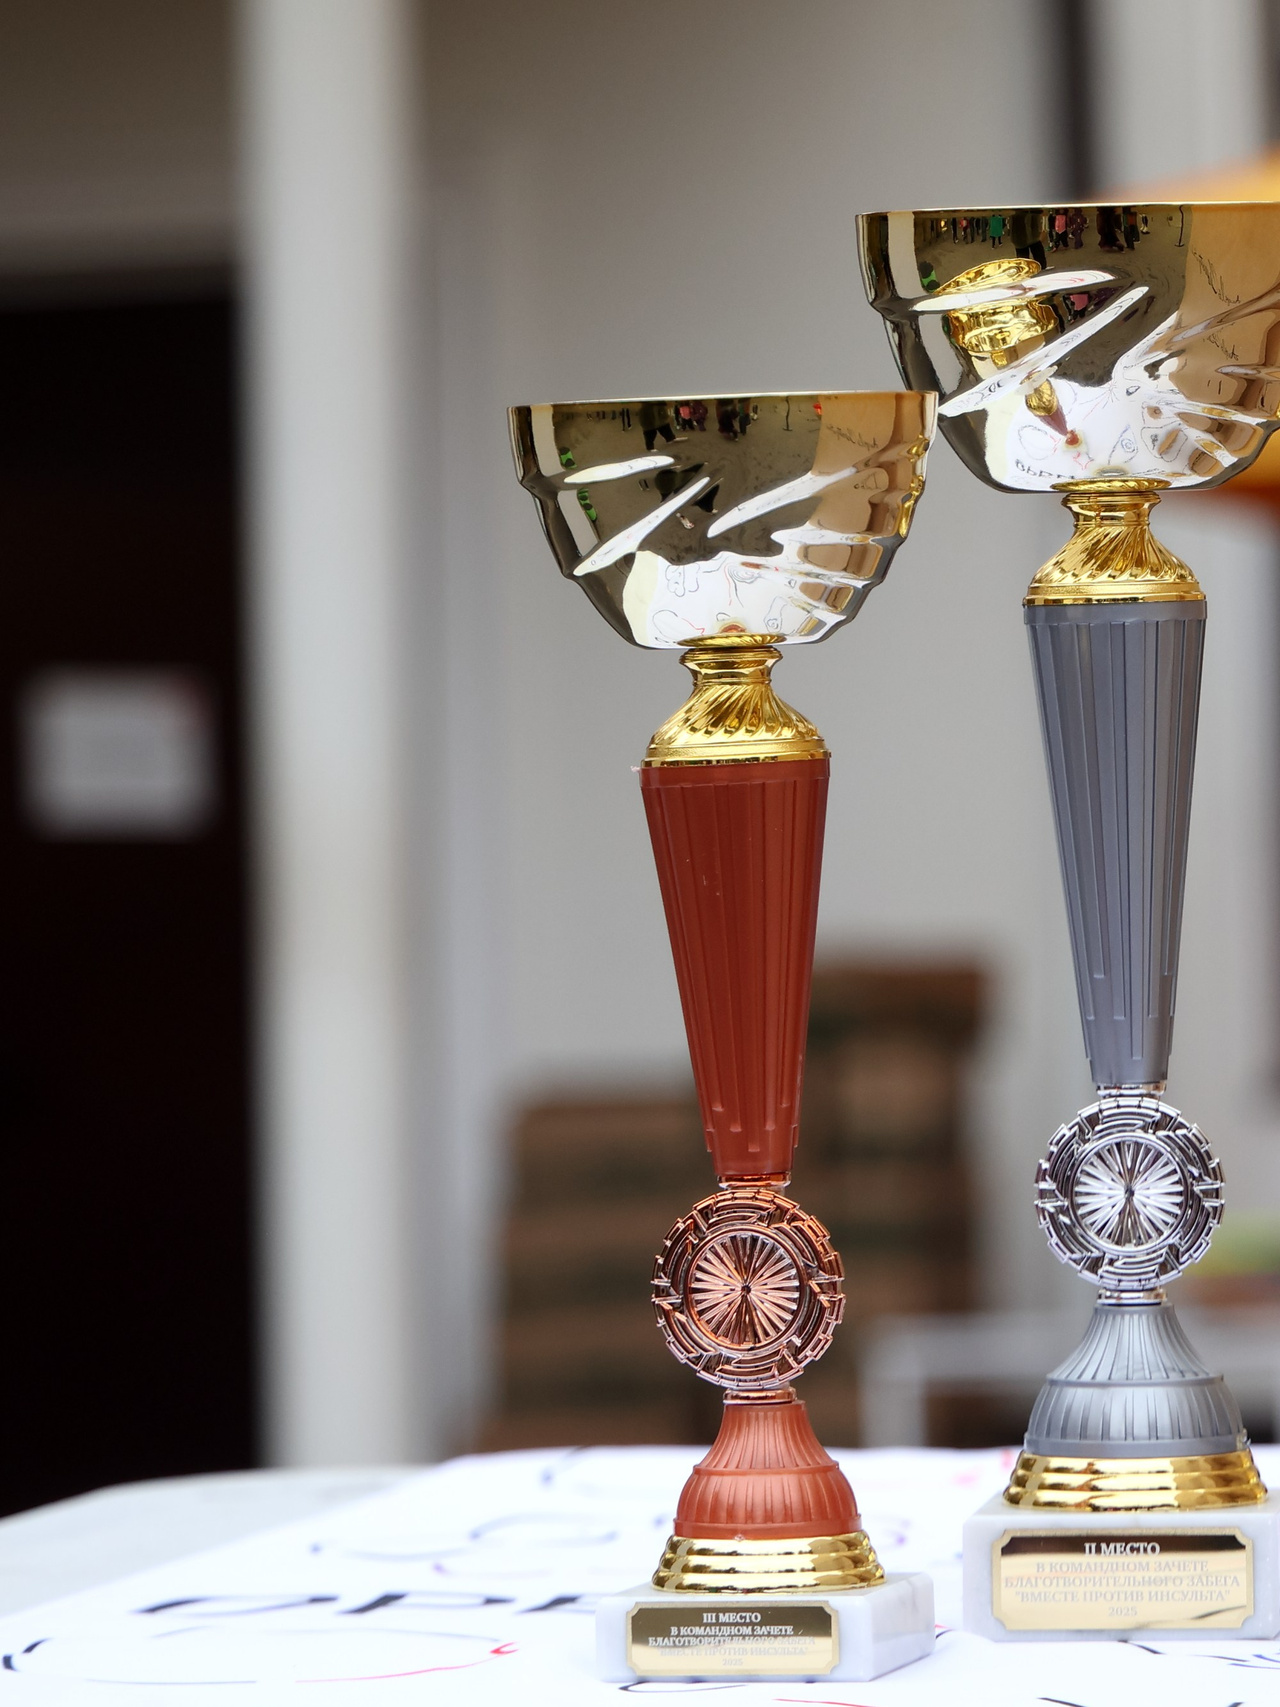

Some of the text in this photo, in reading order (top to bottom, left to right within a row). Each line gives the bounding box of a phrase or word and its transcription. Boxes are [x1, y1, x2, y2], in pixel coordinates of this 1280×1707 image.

[1099, 1541, 1161, 1557] МЕСТО
[1036, 1559, 1209, 1577] В КОМАНДНОМ ЗАЧЕТЕ
[1003, 1574, 1241, 1590] БЛАГОТВОРИТЕЛЬНОГО ЗАБЕГА
[1015, 1589, 1231, 1604] "ВМЕСТЕ ПРОТИВ ИНСУЛЬТА"
[1107, 1605, 1139, 1617] 2025
[702, 1612, 762, 1624] III МЕСТО
[670, 1625, 794, 1638] В КОМАНДНОМ ЗАЧЕТЕ
[648, 1635, 776, 1648] БЛАГОТВОРИТЕЛЬНОГО
[721, 1658, 744, 1667] 2025
